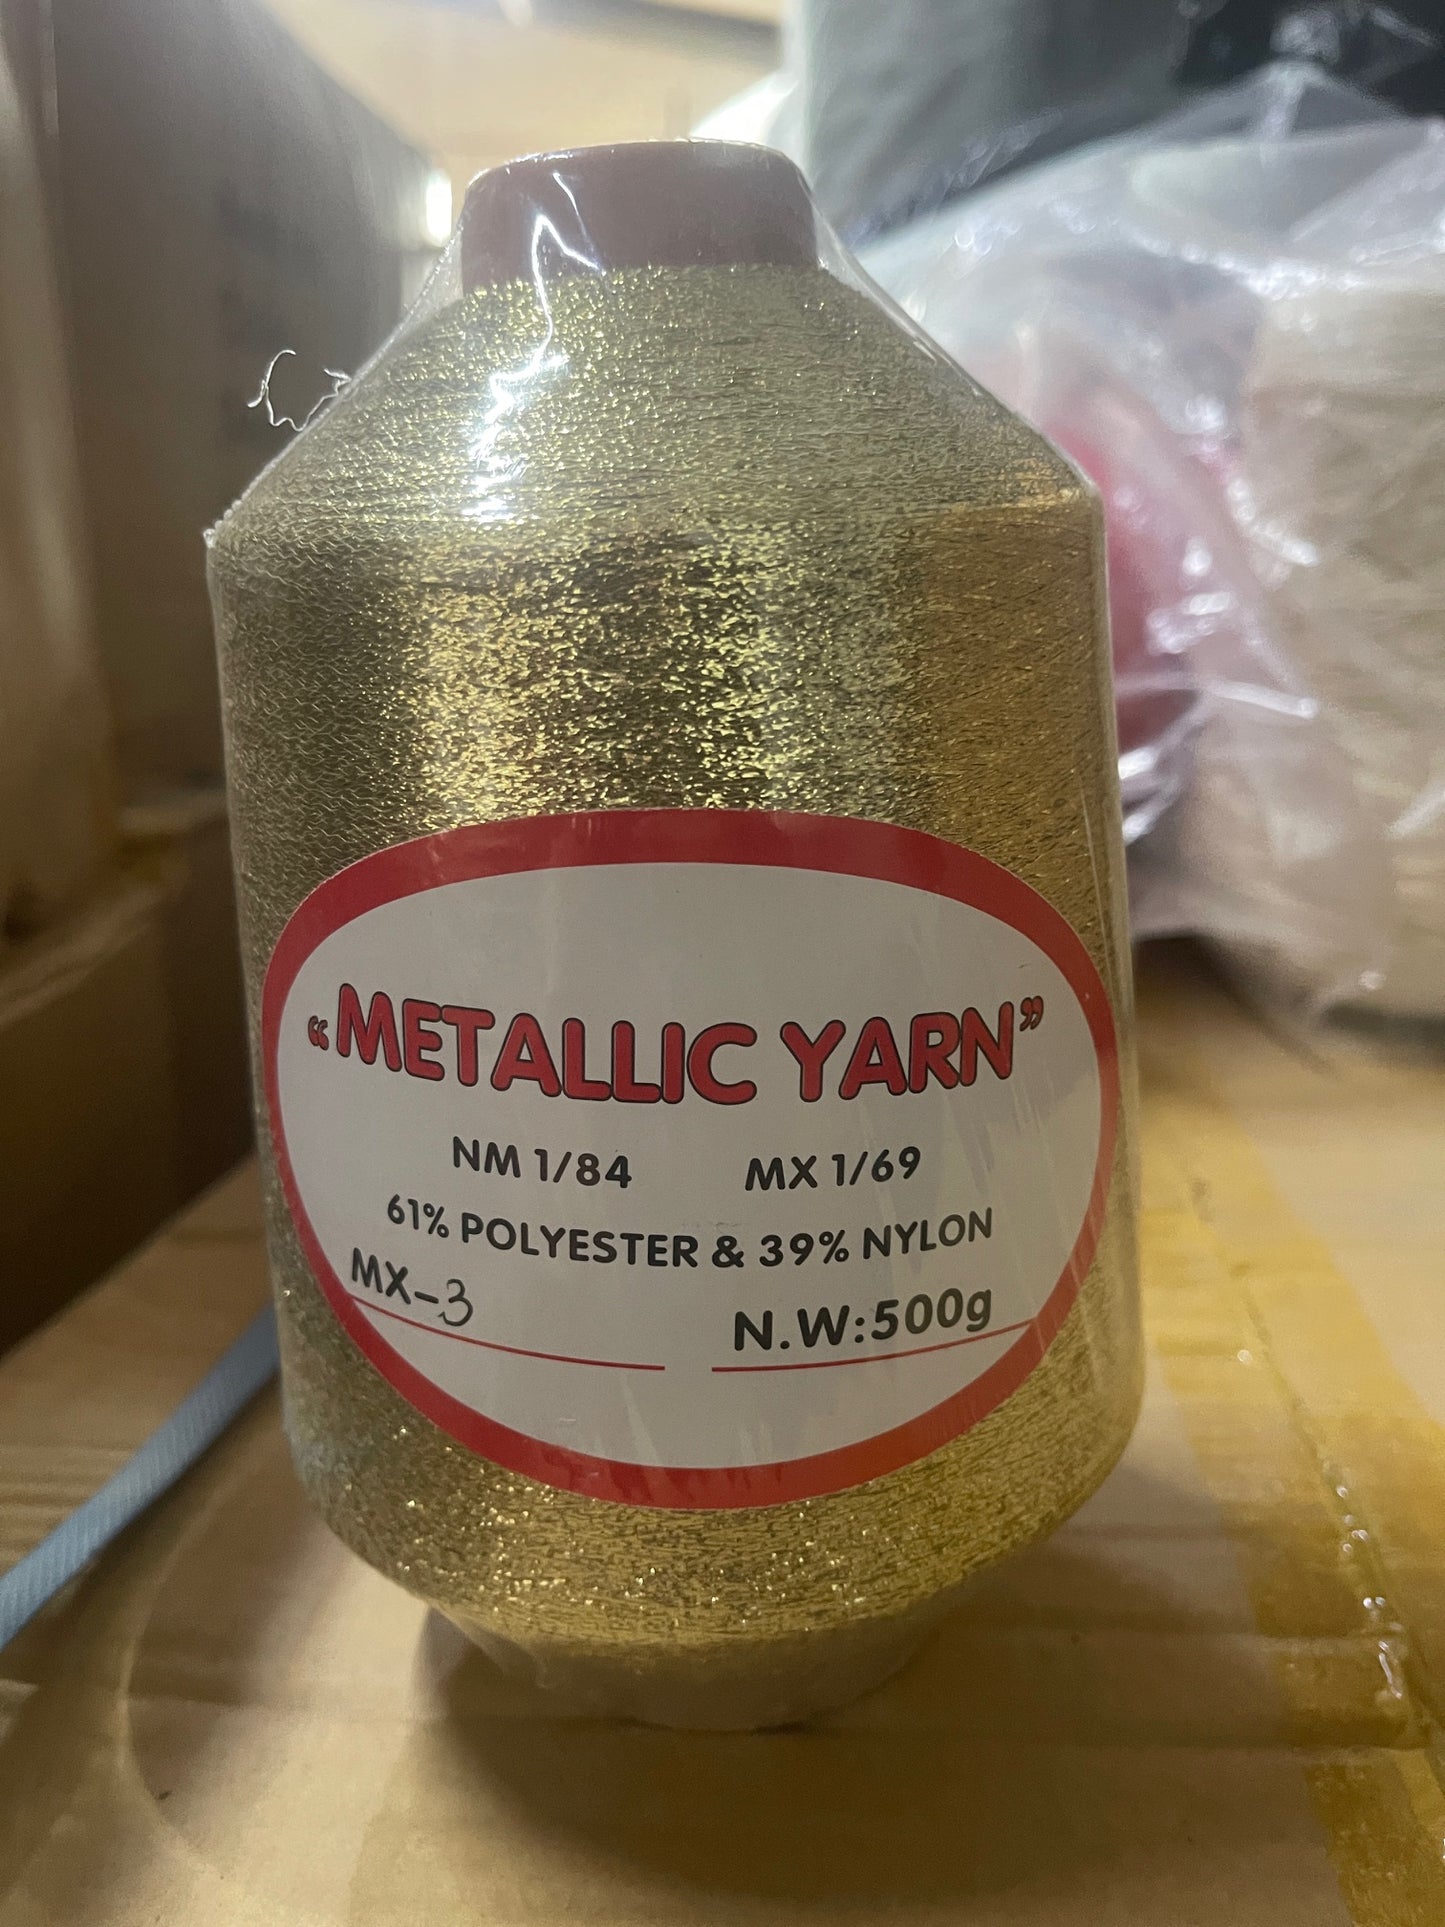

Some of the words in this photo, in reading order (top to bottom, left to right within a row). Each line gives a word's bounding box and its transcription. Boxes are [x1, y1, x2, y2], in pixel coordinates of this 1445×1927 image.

[453, 1136, 521, 1178] NM
[534, 1148, 632, 1188] 1/84
[745, 1156, 818, 1191] MX
[832, 1146, 921, 1187] 1/69
[387, 1194, 450, 1239] 61%
[461, 1212, 699, 1267] POLYESTER
[711, 1235, 744, 1268] &
[759, 1229, 850, 1267] 39%
[863, 1207, 993, 1260] NYLON
[734, 1287, 992, 1351] N.W:500g
